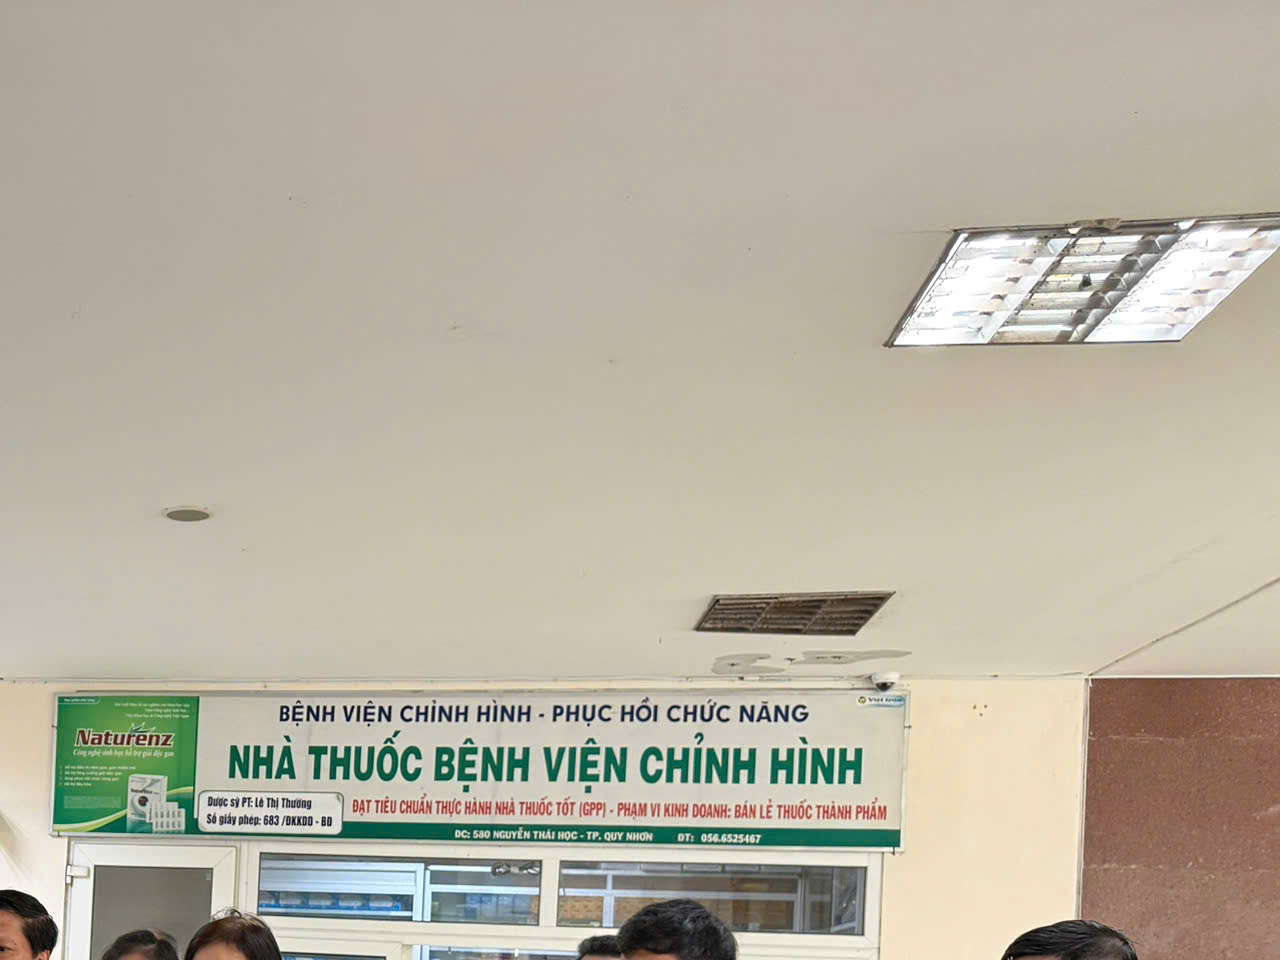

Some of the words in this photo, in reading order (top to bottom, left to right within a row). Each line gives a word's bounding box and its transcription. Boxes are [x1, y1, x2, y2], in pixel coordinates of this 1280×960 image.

[279, 700, 335, 726] BỆNH
[343, 700, 392, 726] VIỆN
[400, 699, 469, 723] CHỈNH
[477, 699, 532, 723] HÌNH
[552, 704, 612, 727] PHỤC
[621, 697, 658, 723] HỒI
[666, 699, 731, 723] CHỨC
[739, 701, 809, 723] NĂNG
[76, 729, 173, 746] Naturenz
[228, 735, 296, 779] NHÀ
[308, 730, 422, 782] THUỐC
[434, 738, 530, 793] BỆNH
[543, 737, 628, 794] VIỆN
[639, 732, 757, 784] CHỈNH
[770, 737, 863, 784] HÌNH
[208, 796, 228, 808] Dược
[241, 797, 253, 808] PT:
[266, 798, 279, 810] Thị
[352, 799, 371, 816] ĐẠT
[375, 796, 396, 814] TIÊU
[400, 793, 432, 814] CHUẨN
[435, 798, 462, 817] THỰC
[465, 797, 492, 815] HÀNH
[495, 797, 516, 816] NHÀ
[519, 796, 553, 816] THUỐC
[556, 796, 576, 816] TỐT
[579, 802, 606, 818] (GPP)
[617, 803, 647, 820] PHẠM
[650, 803, 660, 817] VI
[664, 804, 689, 818] KINH
[692, 804, 731, 818] DOANH:
[734, 800, 756, 819] BÁN
[777, 798, 812, 819] THUỐC
[816, 800, 851, 820] THÀNH
[856, 797, 888, 820] PHẨM
[206, 812, 217, 824] Số
[263, 815, 279, 826] 683
[473, 830, 491, 840] 580
[493, 827, 530, 840] NGUYỄN
[533, 829, 555, 840] THÁI
[558, 831, 578, 842] HỌC
[587, 832, 601, 841] TP.
[604, 832, 623, 842] QUY
